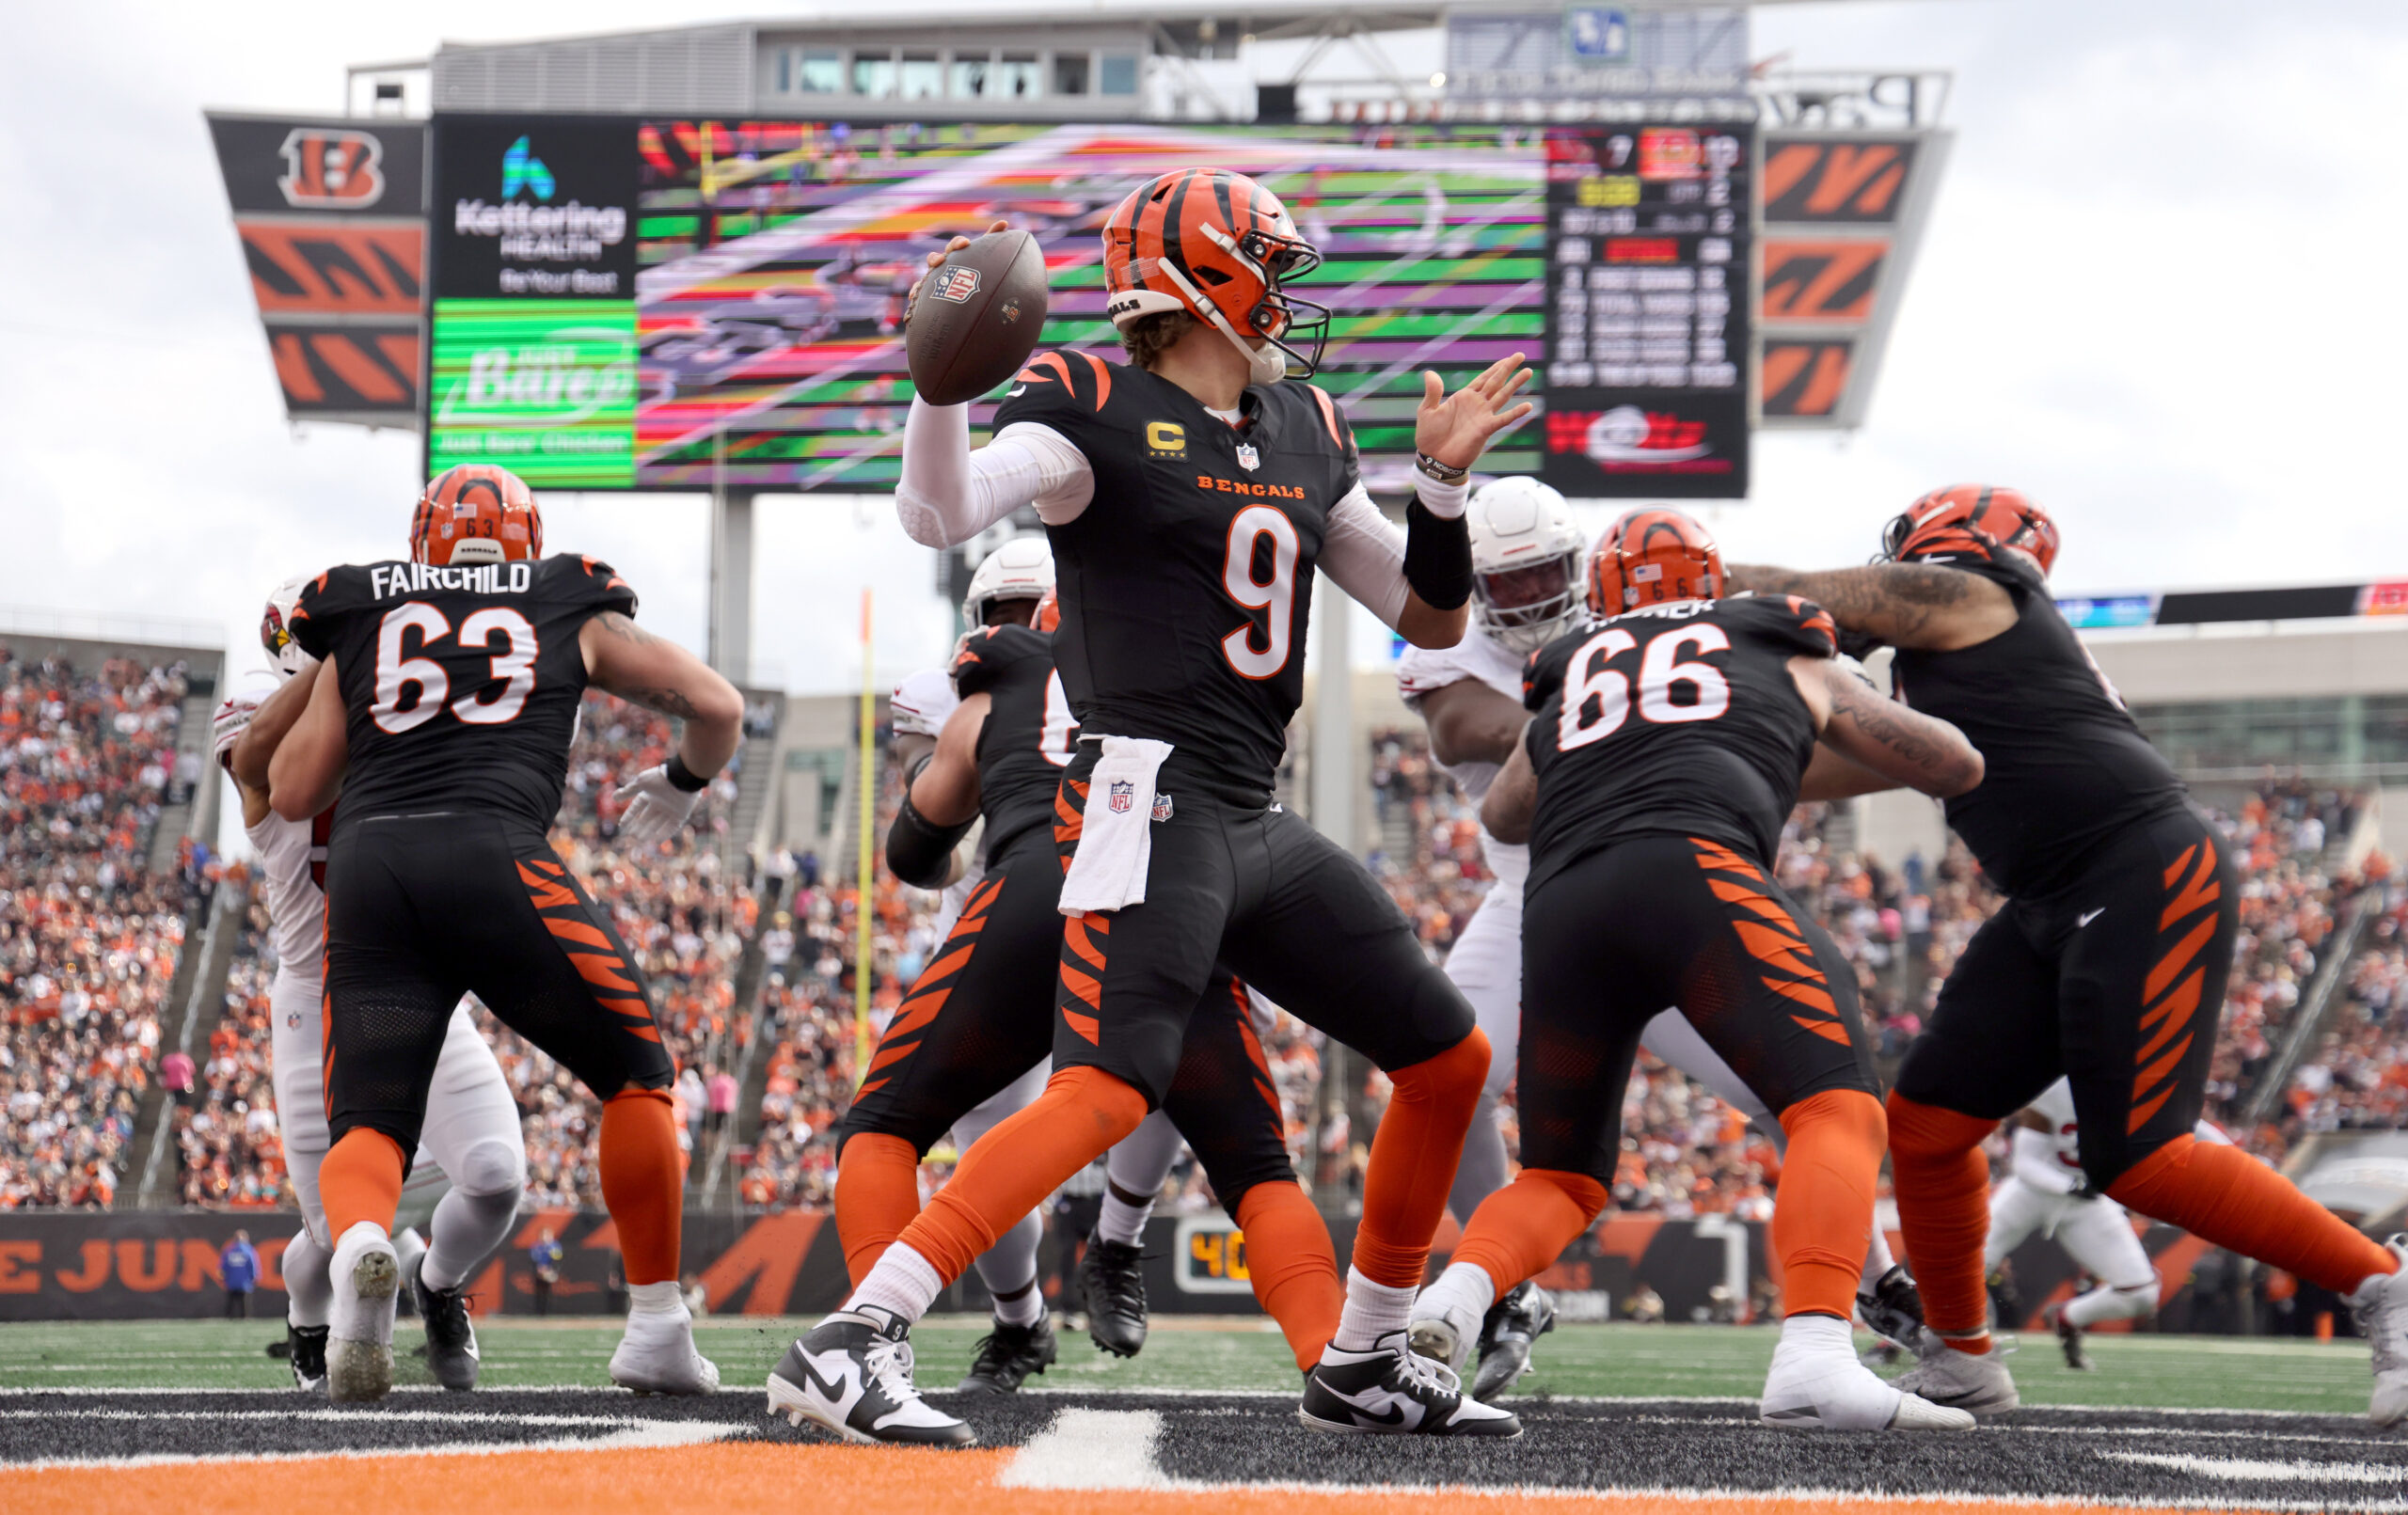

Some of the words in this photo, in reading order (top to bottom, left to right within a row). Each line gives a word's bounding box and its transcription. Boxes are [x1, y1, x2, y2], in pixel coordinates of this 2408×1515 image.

[455, 197, 627, 246] Kettering
[946, 271, 976, 300] NFL
[1147, 421, 1186, 451] C
[1242, 455, 1257, 466] NFL
[1433, 461, 1464, 476] NOBODY
[1196, 475, 1306, 500] BENGALS
[466, 517, 494, 537] 63
[371, 563, 531, 600] FAIRCHILD
[1221, 503, 1301, 680] 9
[1652, 577, 1688, 601] 66
[369, 600, 540, 734] 63
[1557, 622, 1733, 751] 66
[1111, 795, 1130, 811] NFL
[1152, 806, 1170, 818] NFL
[892, 1324, 903, 1341] 9
